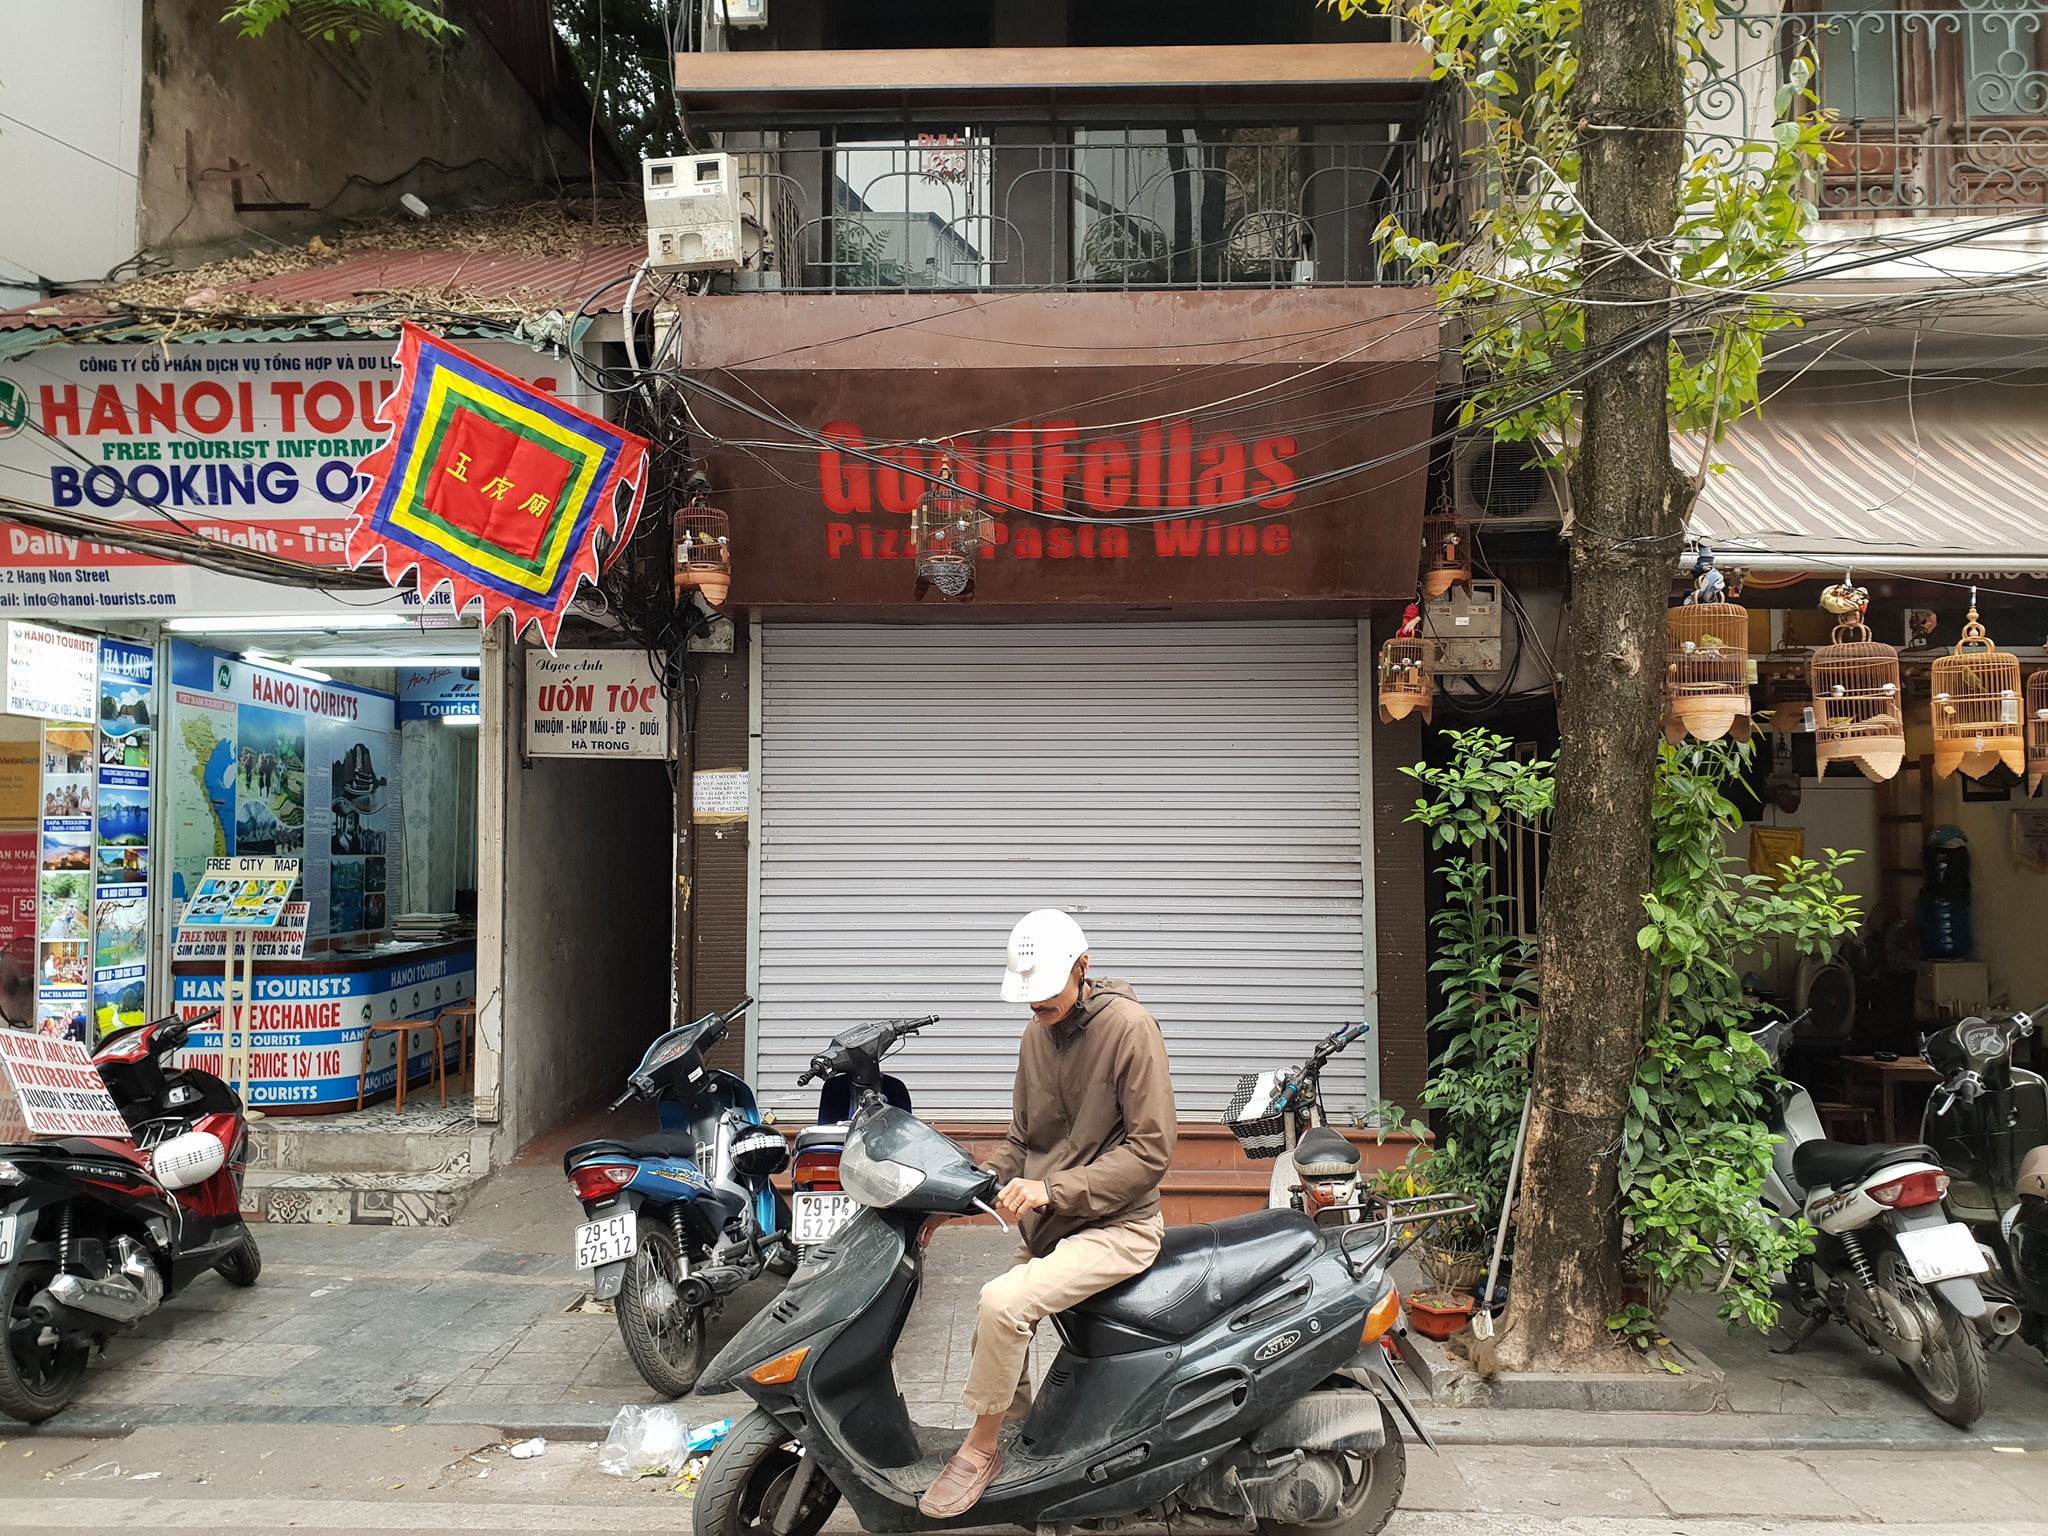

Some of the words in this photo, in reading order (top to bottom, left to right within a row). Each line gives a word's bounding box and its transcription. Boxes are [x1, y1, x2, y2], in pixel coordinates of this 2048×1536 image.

[79, 356, 117, 372] CÔNG
[206, 358, 238, 374] DỊCH
[242, 358, 260, 374] VỤ
[305, 356, 332, 373] HỢP
[336, 353, 355, 370] VÀ
[358, 357, 377, 370] DU
[39, 380, 254, 436] HANOI
[102, 442, 162, 461] FREE
[168, 440, 269, 460] TOURIST
[276, 438, 388, 459] INFORMA
[51, 461, 299, 507] BOOKING
[9, 528, 79, 560] Daily
[299, 525, 352, 552] Trai
[1153, 519, 1293, 558] Wine
[6, 570, 14, 583] 2
[17, 570, 46, 584] Hang
[49, 570, 72, 583] Non
[75, 569, 110, 583] Street
[0, 593, 20, 606] ail:
[23, 592, 177, 607] info@hanoi-tourists.com
[401, 591, 451, 605] Wesite
[24, 630, 55, 644] HANOI
[56, 635, 94, 653] TOURISTS
[103, 648, 120, 674] HA
[122, 652, 150, 679] LONG
[536, 659, 571, 673] Ngọc
[252, 673, 300, 710] HANOI
[303, 687, 358, 721] TOURISTS
[538, 676, 595, 712] UỐN
[606, 678, 657, 713] TÓC
[420, 702, 477, 716] Tourist
[534, 716, 564, 736] NHUỘM
[571, 738, 588, 749] HÀ
[591, 741, 630, 750] TRONG
[206, 858, 231, 870] FREE
[239, 858, 264, 871] CITY
[274, 859, 298, 871] MAP
[283, 903, 307, 914] OFFEE
[276, 916, 289, 927] ALL
[179, 931, 202, 943] FREE
[177, 944, 193, 956] SIM
[194, 944, 216, 955] CARD
[256, 944, 276, 955] DETA
[278, 944, 289, 955] 3G
[290, 944, 302, 955] 4G
[390, 967, 416, 988] HANOI
[416, 960, 447, 980] TOURISTS
[255, 977, 351, 997] TOURISTS
[182, 1005, 243, 1031] MONY
[249, 1002, 342, 1031] EXCHANGE
[0, 1034, 17, 1057] OR
[14, 1036, 43, 1061] RENT
[42, 1040, 67, 1063] AND
[63, 1043, 94, 1066] SELL
[316, 1049, 340, 1076] 1KG
[22, 1088, 66, 1110] AUNDRY
[63, 1092, 117, 1111] SERVICES
[68, 1113, 129, 1134] EXCHANGE
[585, 1216, 624, 1244] 29-C1
[803, 1218, 847, 1237] 522
[580, 1236, 631, 1266] 525.12
